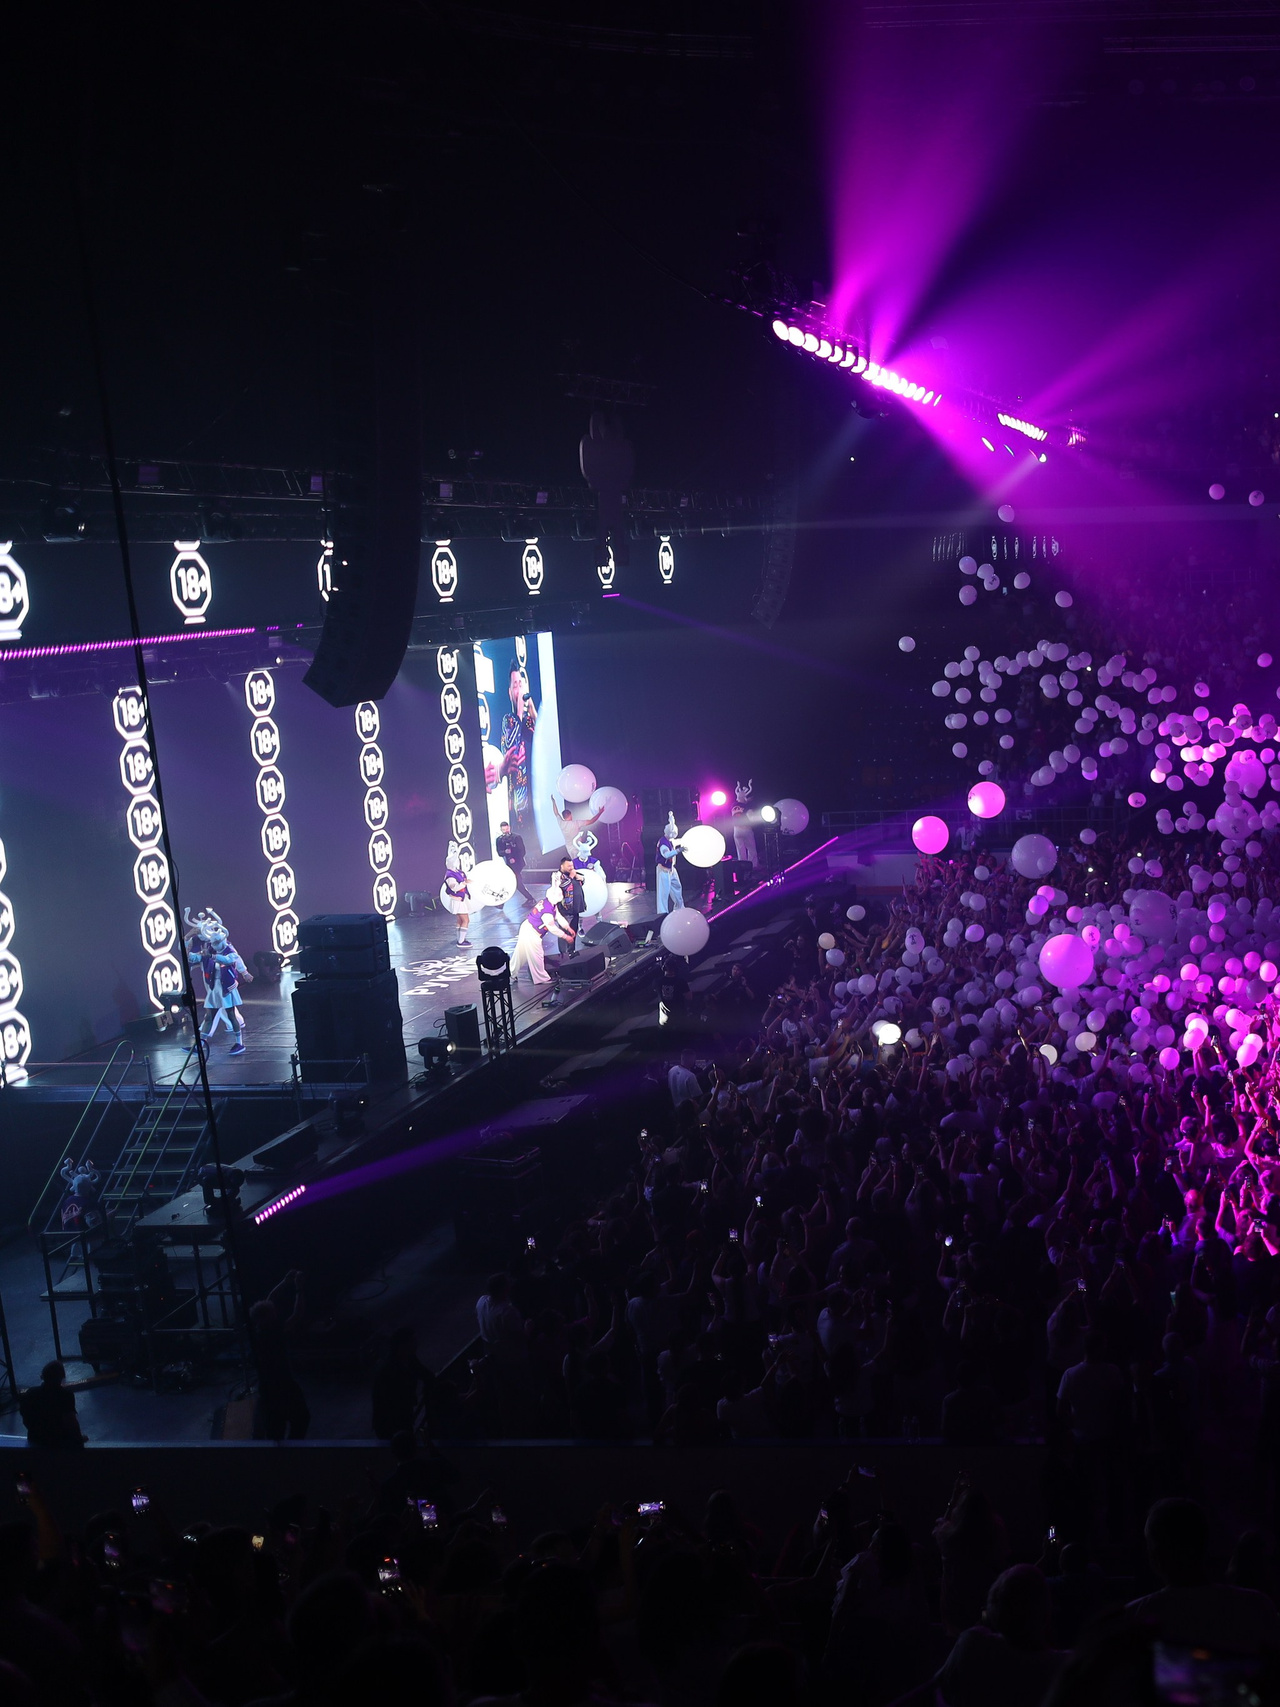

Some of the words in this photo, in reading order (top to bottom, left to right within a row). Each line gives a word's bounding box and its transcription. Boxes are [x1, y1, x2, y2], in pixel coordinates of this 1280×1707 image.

[436, 559, 454, 584] 18+
[526, 556, 541, 578] 18+
[177, 567, 207, 601] 18+
[251, 679, 272, 705] 18+
[119, 696, 145, 727] 18+
[359, 709, 377, 732] 18+
[255, 728, 277, 754] 18+
[126, 752, 153, 782] 18+
[364, 754, 381, 776] 18+
[261, 778, 282, 803] 18+
[133, 806, 159, 836] 18+
[368, 797, 385, 820] 18+
[266, 825, 287, 851] 18+
[372, 840, 390, 863] 18+
[140, 860, 167, 891] 18+
[272, 874, 293, 899] 18+
[376, 883, 394, 906] 18+
[147, 913, 173, 944] 18+
[277, 921, 297, 947] 18+
